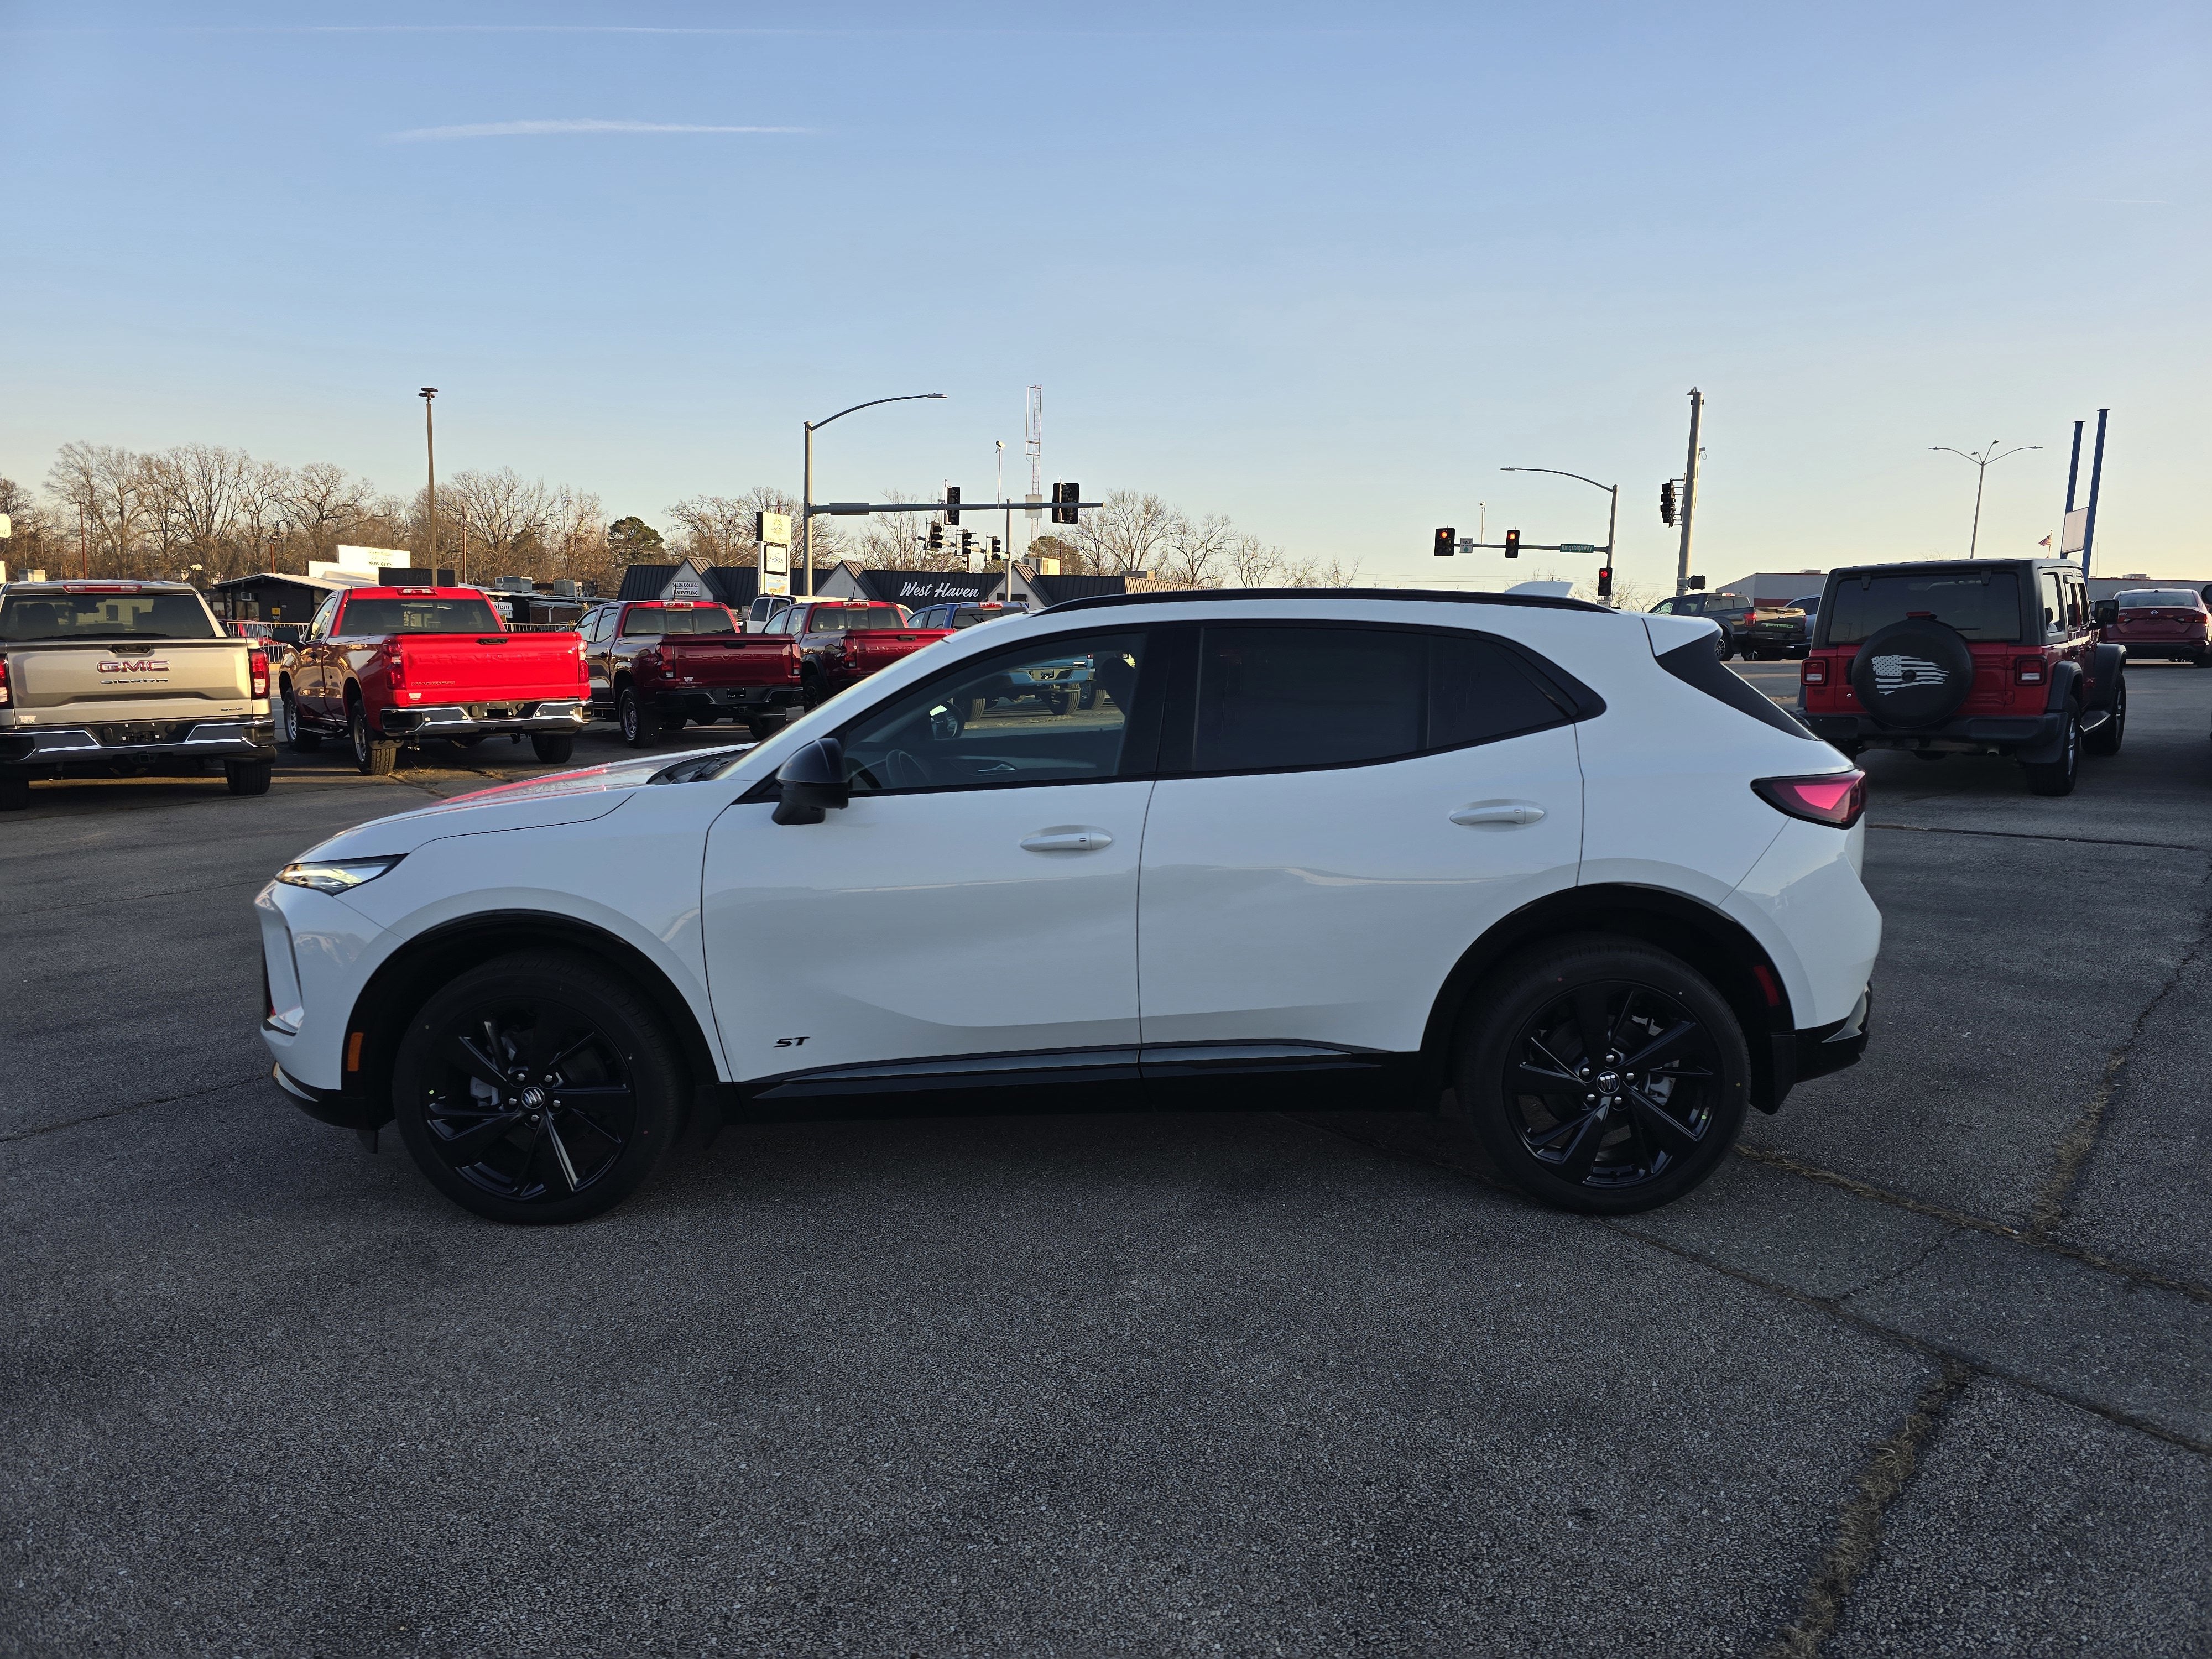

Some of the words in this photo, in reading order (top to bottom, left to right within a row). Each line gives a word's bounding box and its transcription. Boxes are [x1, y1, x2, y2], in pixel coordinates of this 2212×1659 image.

[900, 581, 933, 597] West
[933, 582, 980, 598] Haven
[97, 660, 170, 673] GMC
[773, 1036, 810, 1048] ST
